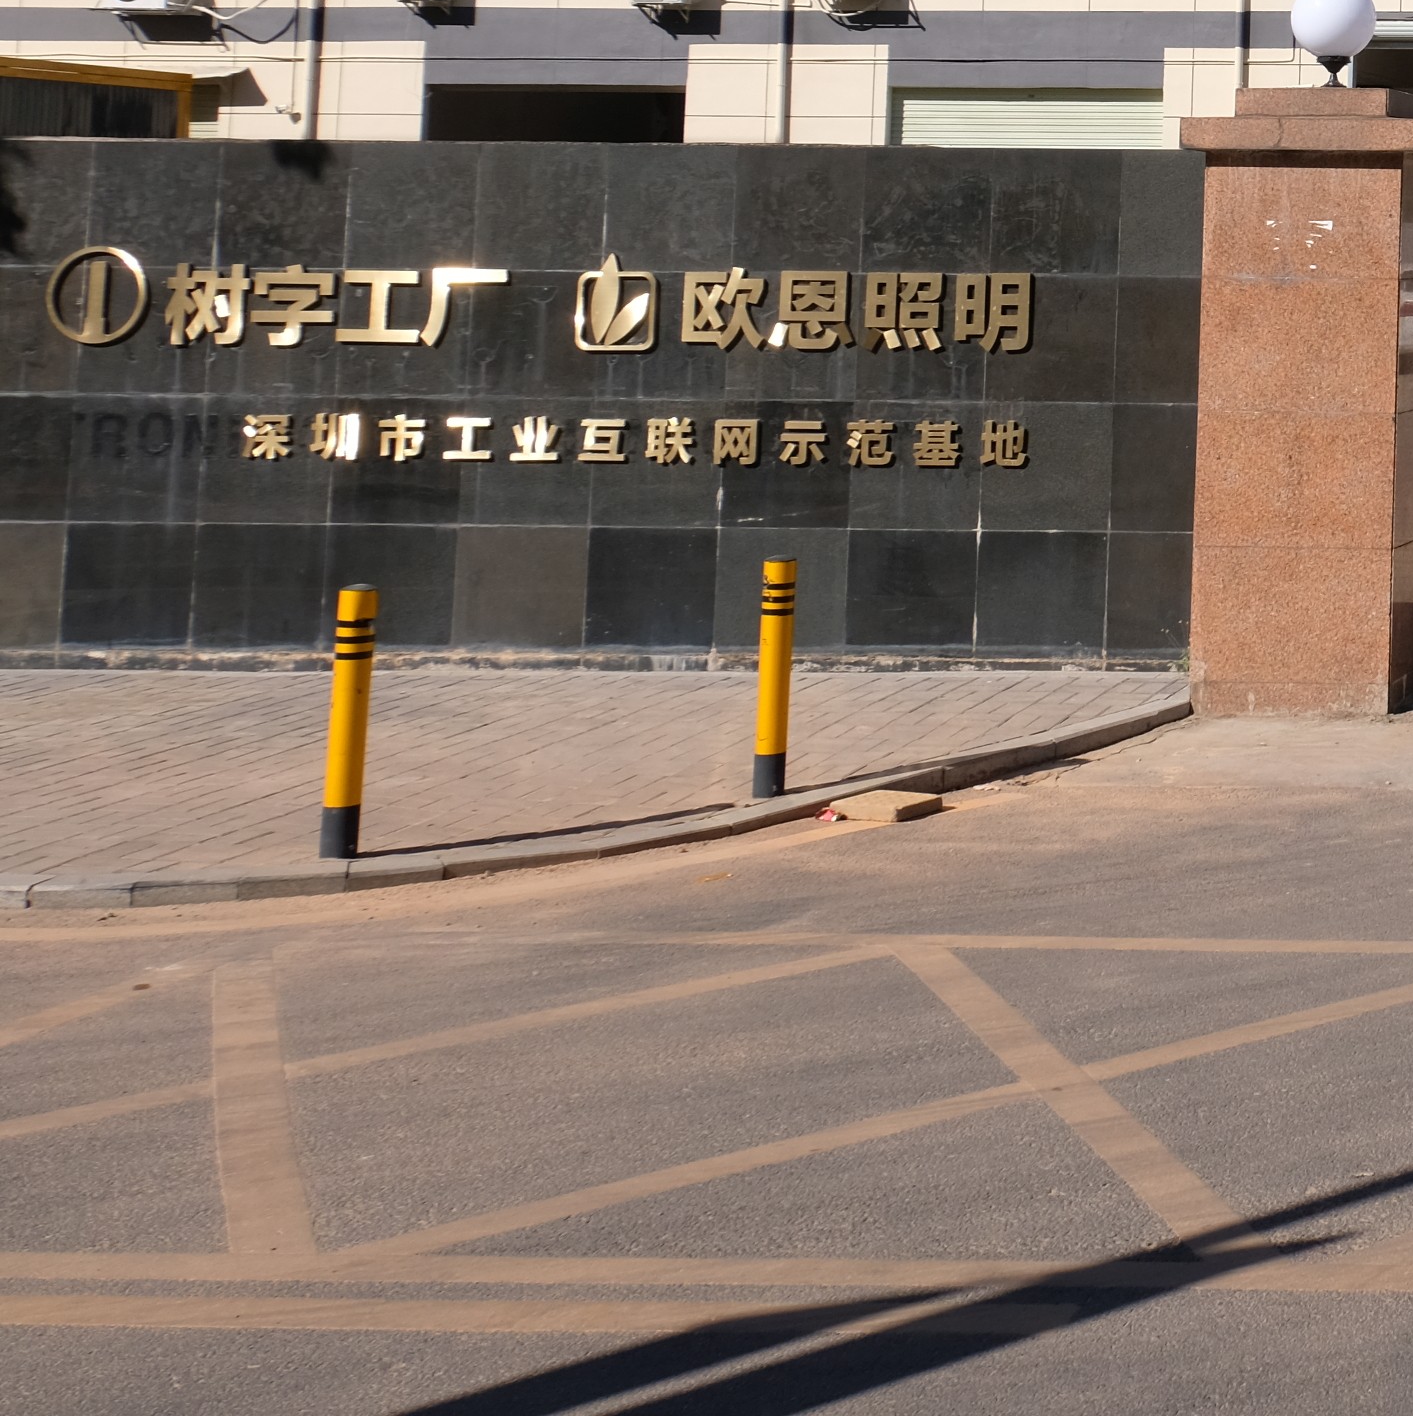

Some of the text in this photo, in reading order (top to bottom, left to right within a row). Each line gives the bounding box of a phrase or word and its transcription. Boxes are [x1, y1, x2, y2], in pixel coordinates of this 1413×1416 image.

[165, 262, 509, 348] 树字工厂
[681, 266, 1035, 352] 欧恩照明
[242, 412, 1030, 468] 深圳市工业互联网示范基地
